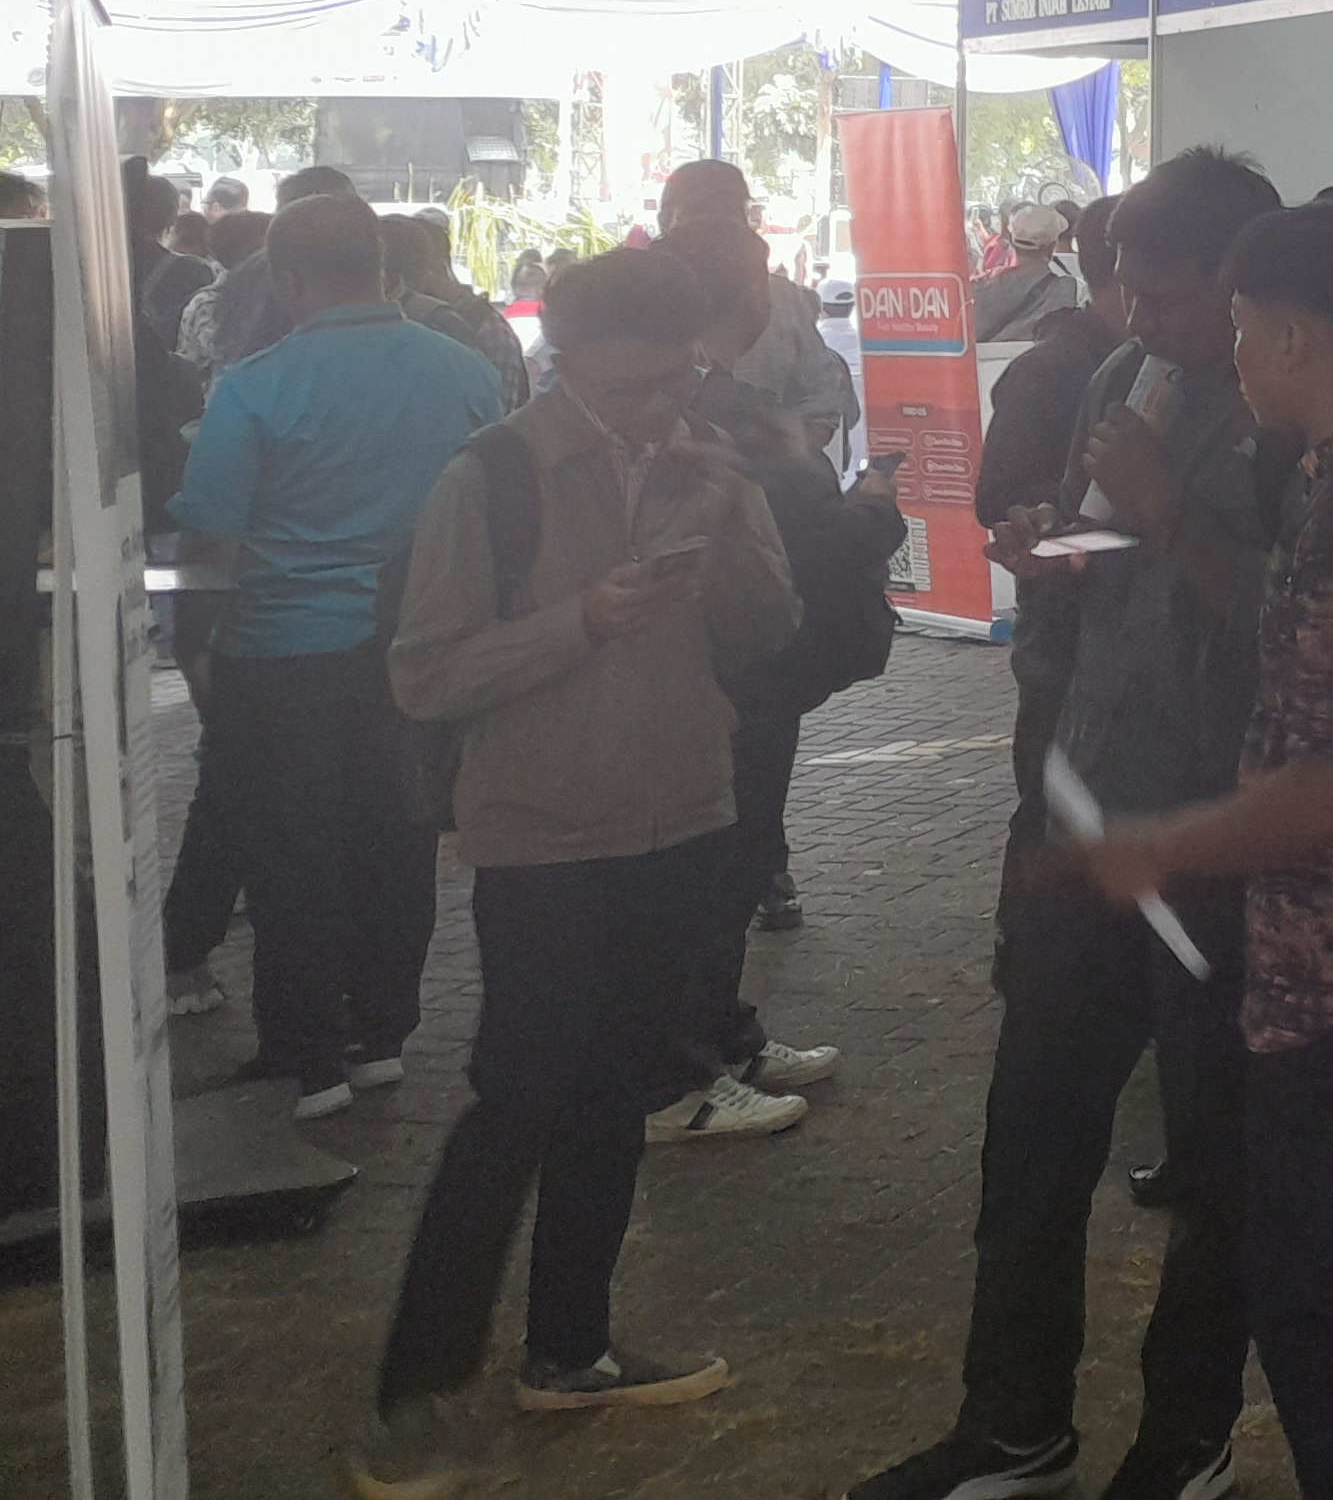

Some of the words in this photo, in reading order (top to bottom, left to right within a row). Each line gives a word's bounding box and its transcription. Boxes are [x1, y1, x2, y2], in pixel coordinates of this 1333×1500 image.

[984, 1, 998, 25] PT
[861, 286, 904, 319] DAN
[909, 286, 950, 319] DAN
